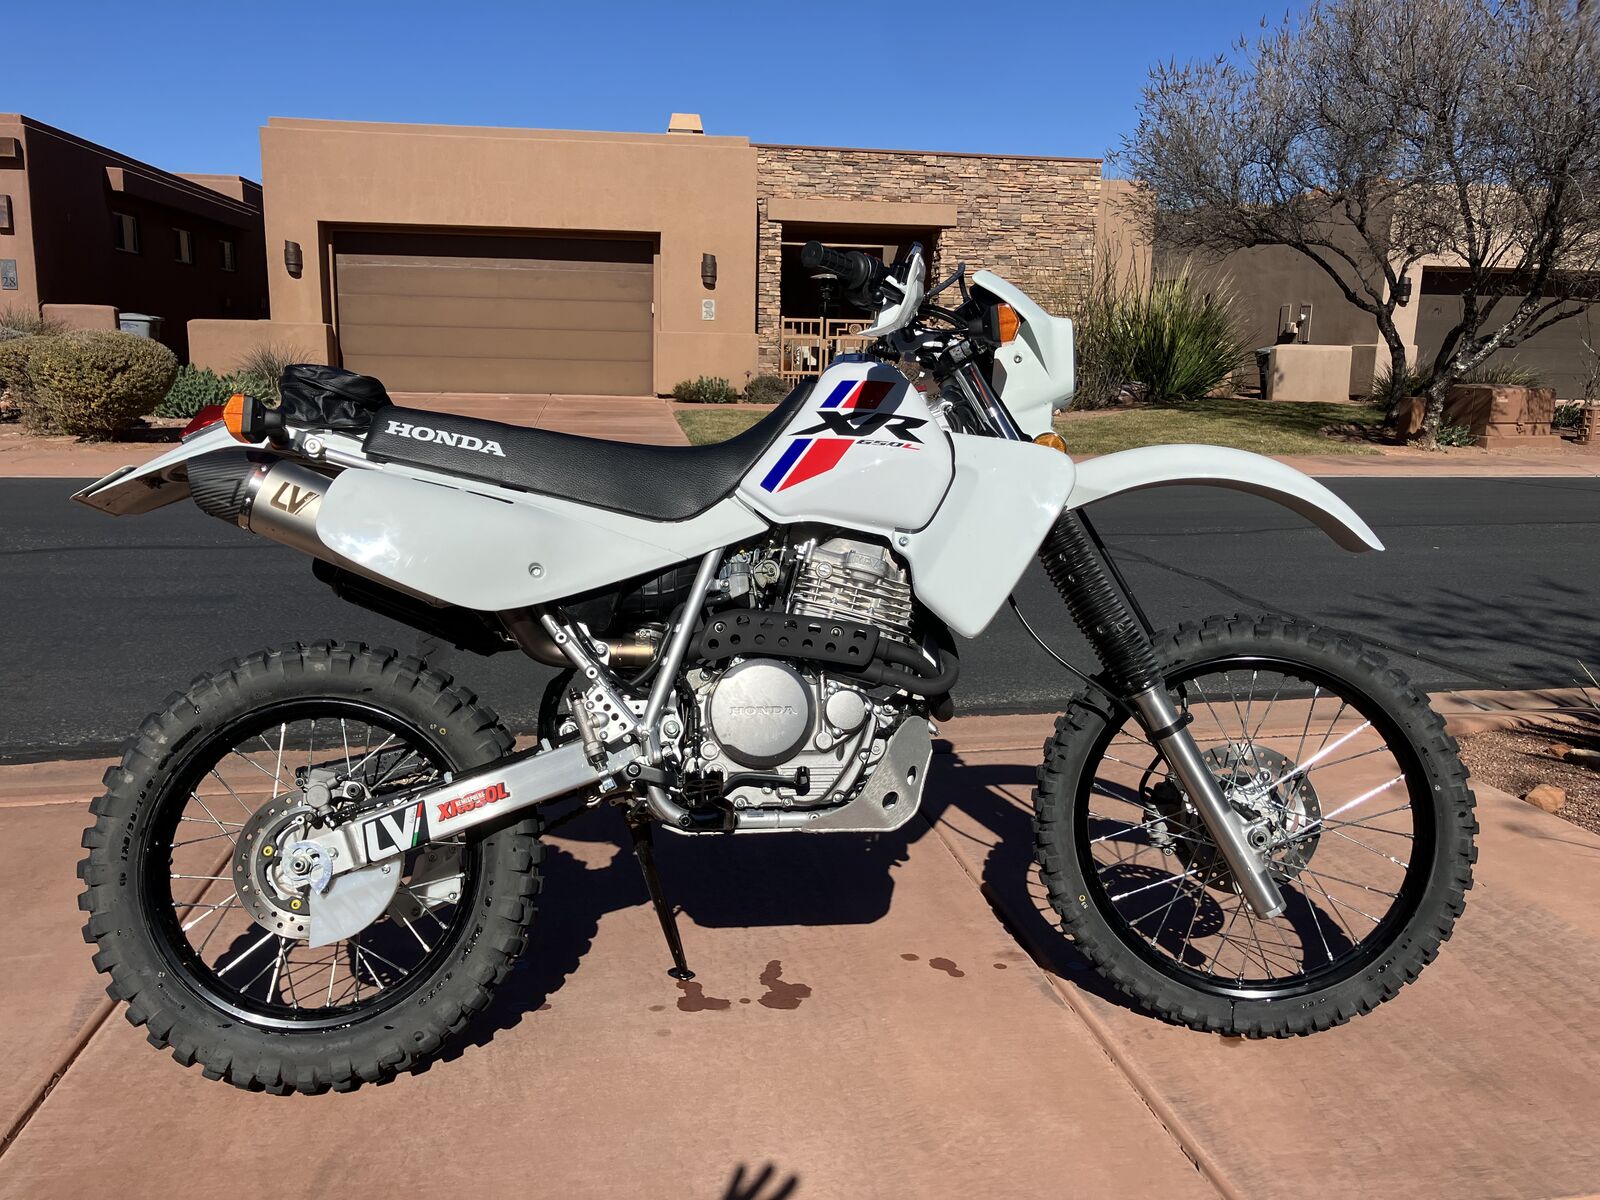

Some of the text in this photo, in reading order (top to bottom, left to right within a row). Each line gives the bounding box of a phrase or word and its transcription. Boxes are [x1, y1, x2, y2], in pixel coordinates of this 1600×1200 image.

[2, 276, 16, 287] 28
[385, 420, 506, 457] HONDA
[788, 411, 929, 444] XR
[856, 439, 920, 450] 650L
[270, 481, 317, 514] LV
[729, 705, 798, 716] HONDA
[365, 803, 418, 862] LV
